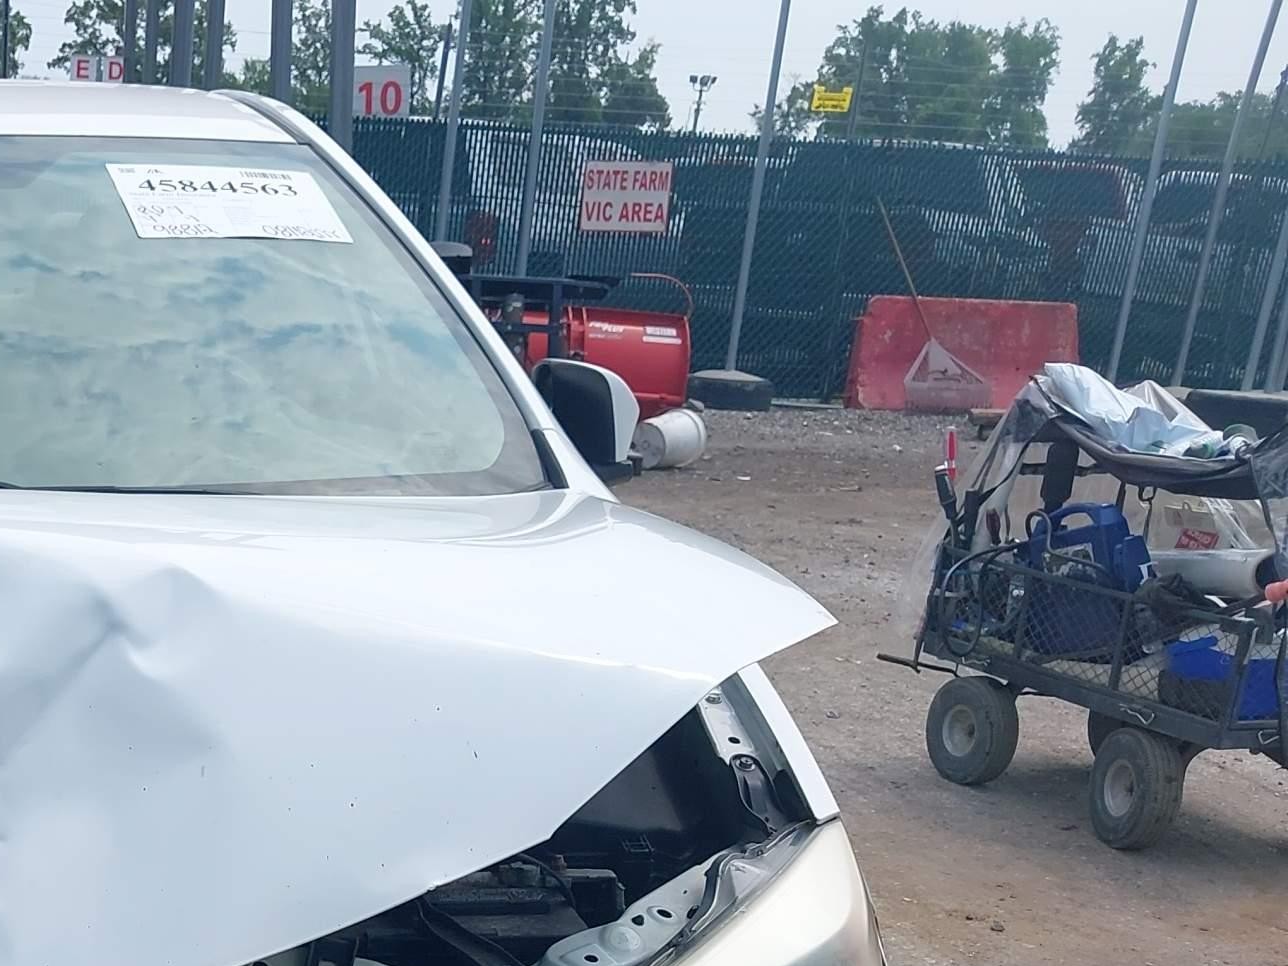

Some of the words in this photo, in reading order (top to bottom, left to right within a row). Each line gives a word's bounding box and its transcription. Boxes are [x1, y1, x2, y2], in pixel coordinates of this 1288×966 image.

[76, 59, 90, 79] E
[108, 60, 124, 80] D
[358, 80, 402, 116] 10
[138, 179, 298, 197] 45844563
[586, 169, 629, 191] STATE
[632, 170, 670, 192] FARM
[585, 201, 614, 222] VIC
[618, 202, 666, 224] AREA
